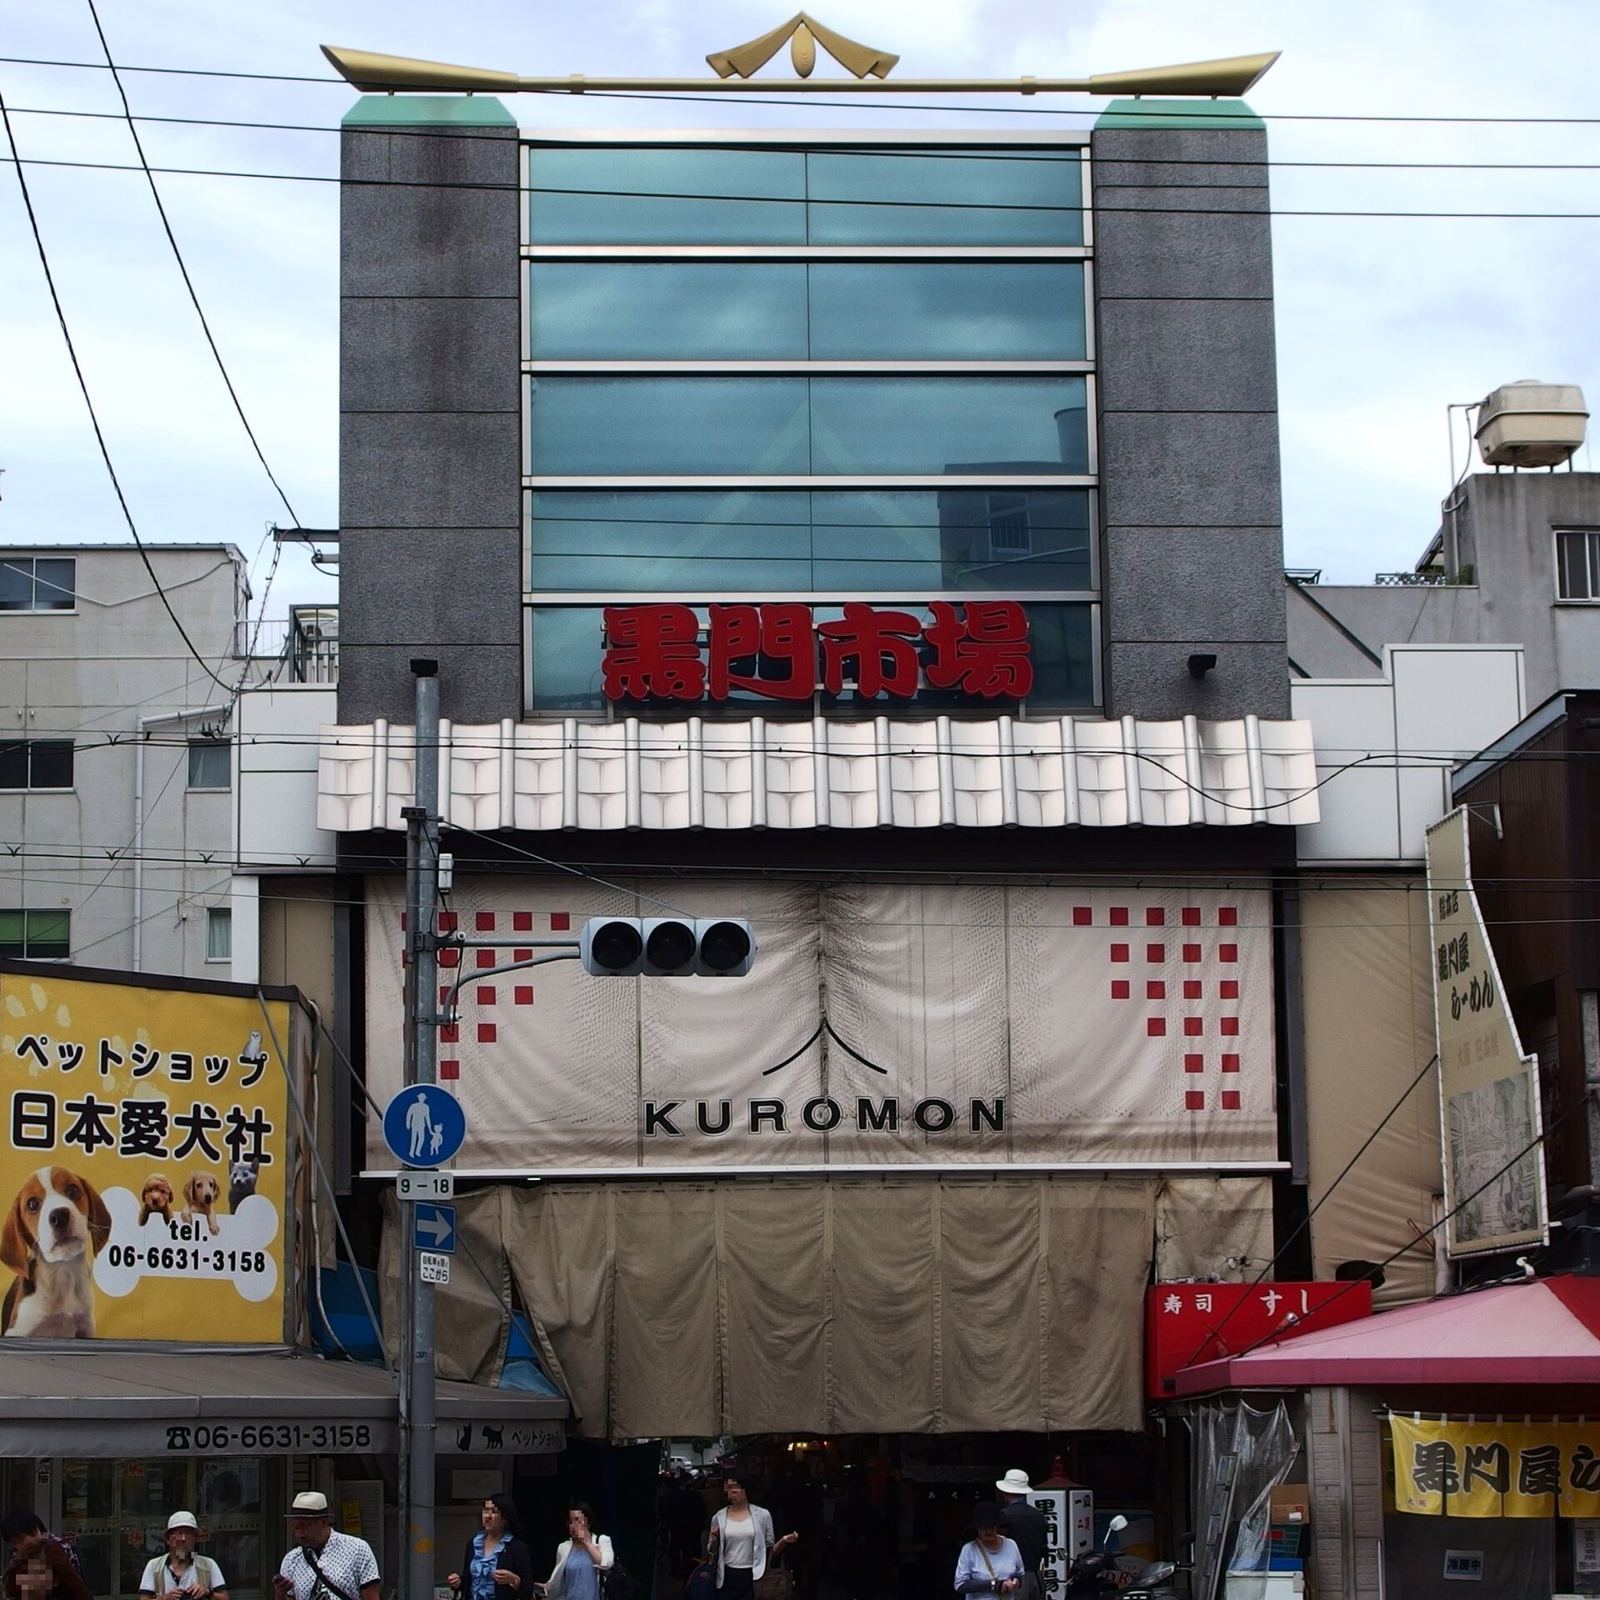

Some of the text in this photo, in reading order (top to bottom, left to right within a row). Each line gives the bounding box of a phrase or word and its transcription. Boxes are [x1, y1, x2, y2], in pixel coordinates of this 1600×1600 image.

[602, 600, 1034, 699] 黒門市場
[17, 1036, 268, 1087] ペットショップ
[12, 1091, 272, 1164] 日本愛犬社
[645, 1096, 1007, 1136] KUROMON
[169, 1220, 208, 1241] tel.
[108, 1245, 266, 1273] 06-6631-3158
[422, 1267, 448, 1282] ここから
[194, 1424, 371, 1449] 06-6631-3158
